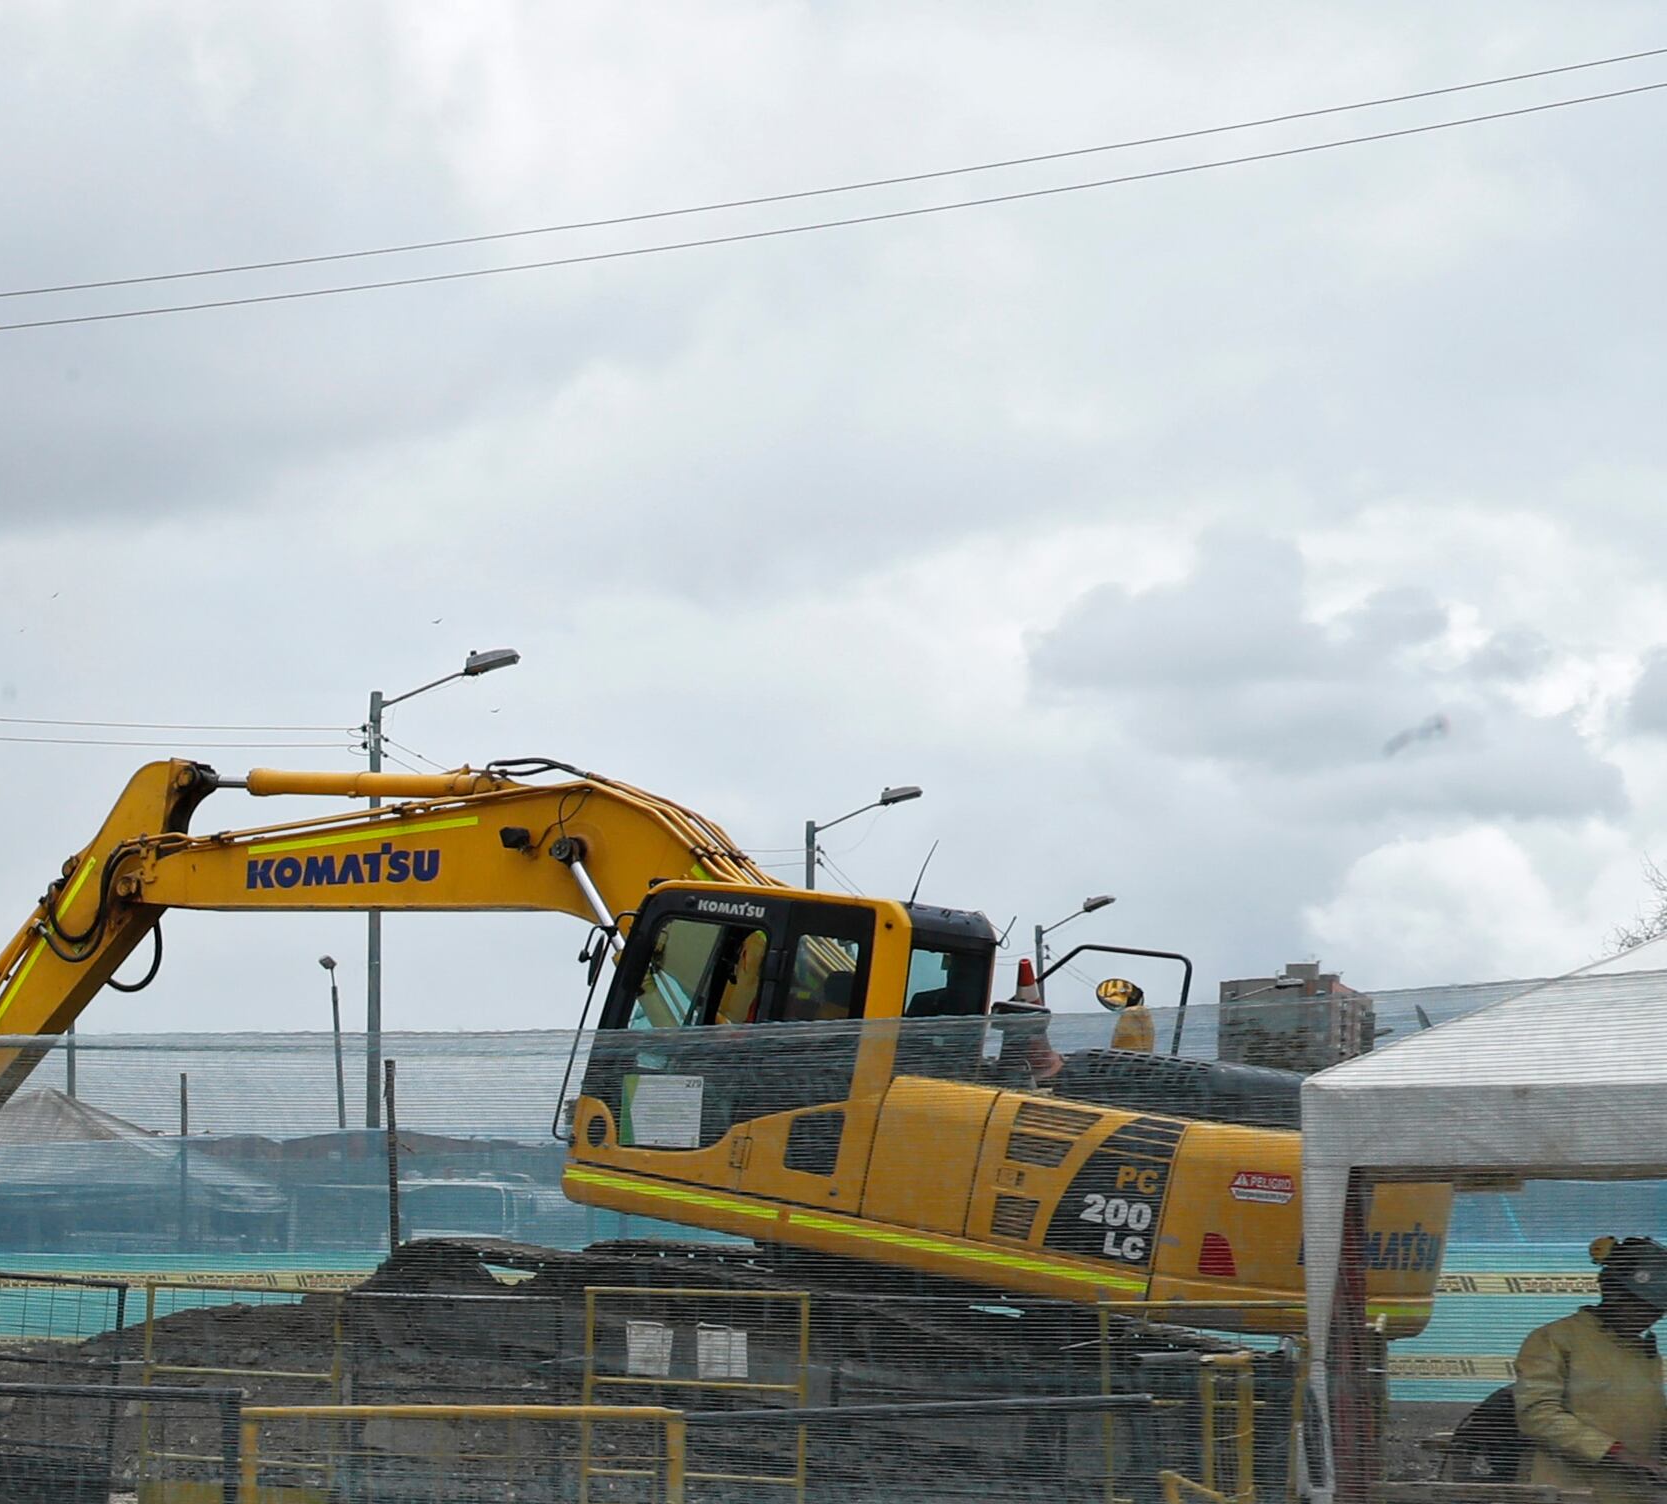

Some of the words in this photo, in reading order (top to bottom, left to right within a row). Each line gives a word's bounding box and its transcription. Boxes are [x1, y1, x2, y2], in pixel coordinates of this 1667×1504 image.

[246, 842, 440, 889] KOMATSU
[697, 899, 766, 918] KOMATSU
[1115, 1166, 1158, 1194] PC
[1079, 1193, 1152, 1231] 200
[1103, 1231, 1145, 1260] LC
